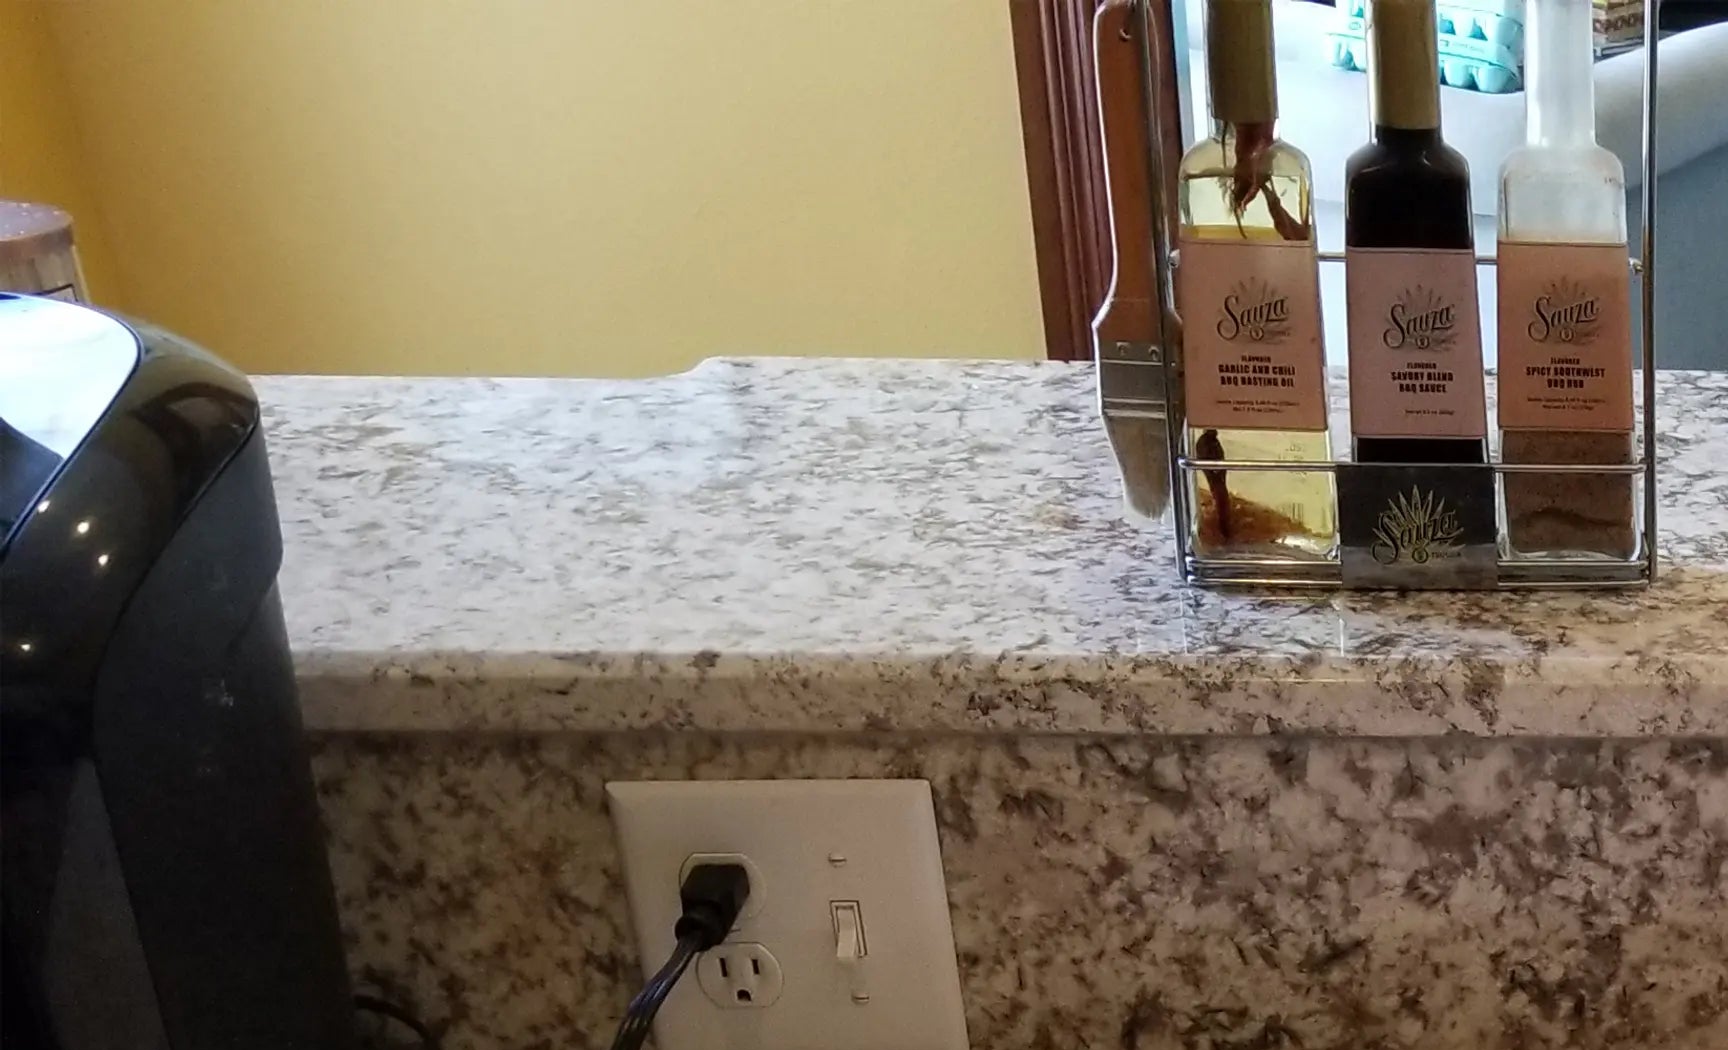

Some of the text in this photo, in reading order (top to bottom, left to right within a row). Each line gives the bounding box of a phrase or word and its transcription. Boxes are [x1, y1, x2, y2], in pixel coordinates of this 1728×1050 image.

[1217, 295, 1289, 341] Sauza
[1527, 296, 1600, 342] Sauza
[1383, 303, 1456, 349] Sauza
[1218, 364, 1250, 374] GARLIC
[1272, 366, 1296, 376] CHILI
[1526, 366, 1606, 378] SPICY SOUTHWEST
[1240, 376, 1279, 387] BASTING
[1281, 378, 1295, 388] OIL
[1391, 371, 1454, 382] SAVORY BLEND
[1419, 383, 1447, 393] SAUCE
[1371, 511, 1464, 565] Sauza
